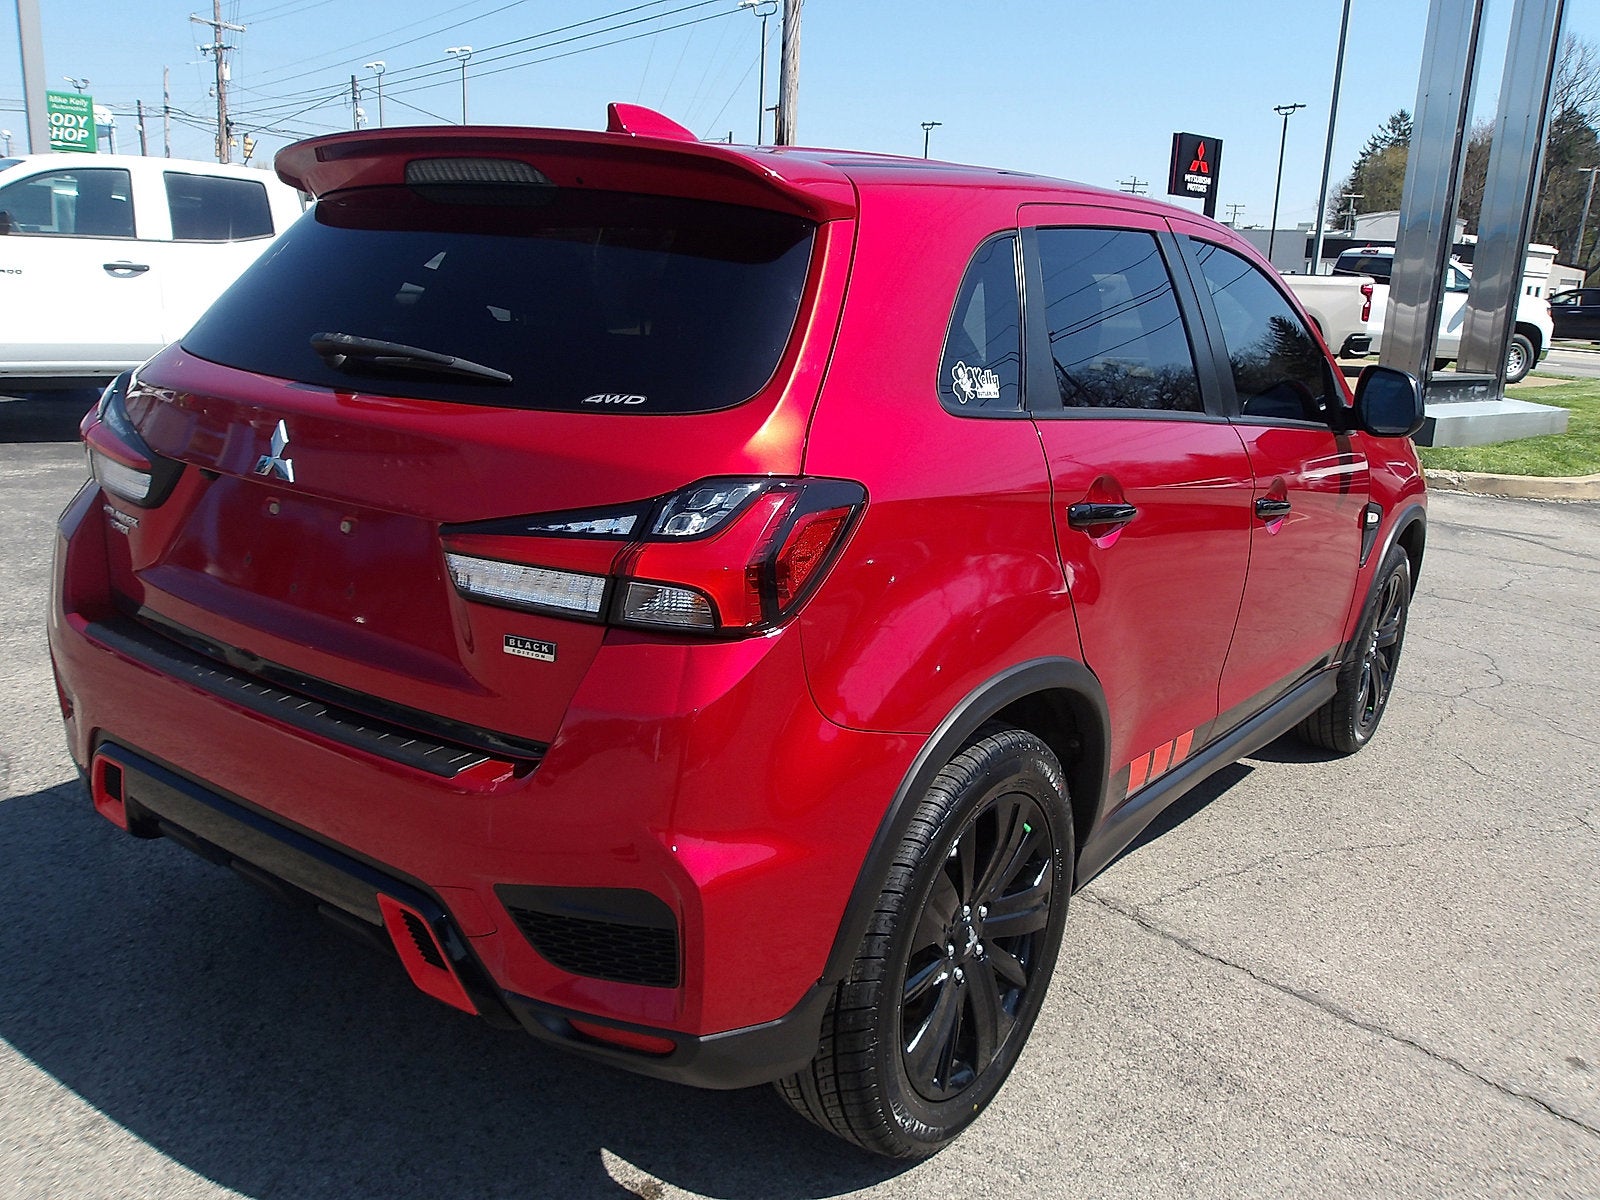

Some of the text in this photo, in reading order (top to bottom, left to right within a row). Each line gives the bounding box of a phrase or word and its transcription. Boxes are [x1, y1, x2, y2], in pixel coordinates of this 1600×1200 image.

[48, 95, 88, 107] Mike Kelly
[1184, 173, 1212, 185] MITSUBISHI
[1186, 182, 1207, 193] MOTORS
[973, 367, 999, 389] Kelly
[582, 394, 646, 405] 4WD
[509, 638, 549, 653] BLACK
[511, 648, 546, 659] EDITION
